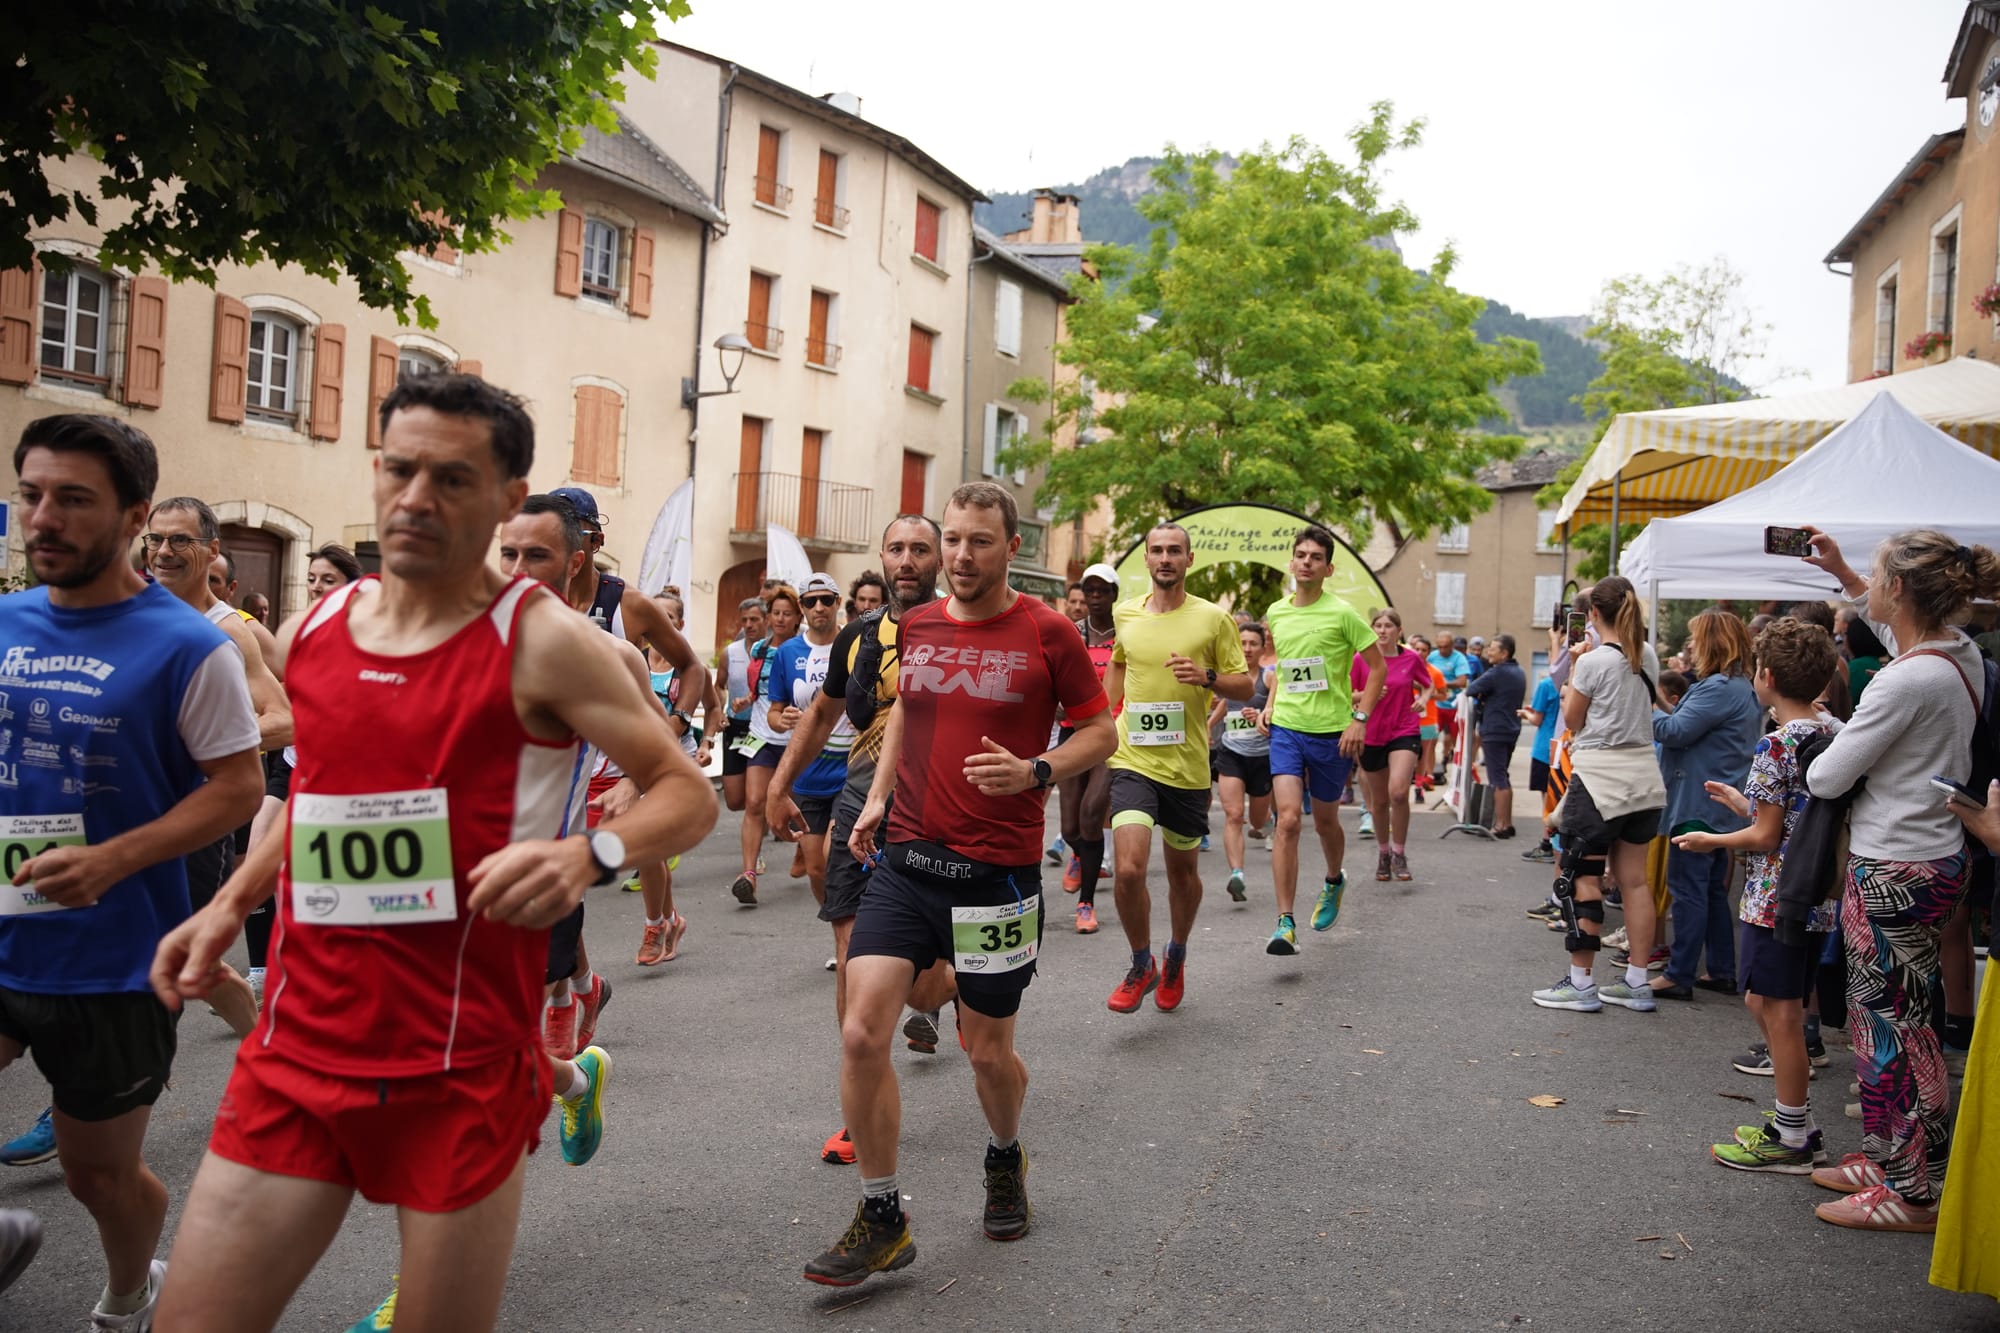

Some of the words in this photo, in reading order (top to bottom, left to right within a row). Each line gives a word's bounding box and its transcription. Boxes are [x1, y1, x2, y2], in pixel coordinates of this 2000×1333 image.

[1187, 525, 1262, 542] Challenge
[902, 644, 1028, 670] LOZÈRE
[900, 665, 1024, 703] TRAIL
[1292, 667, 1312, 681] 21
[1141, 714, 1169, 731] 99
[309, 828, 423, 880] 100
[980, 920, 1022, 951] 35
